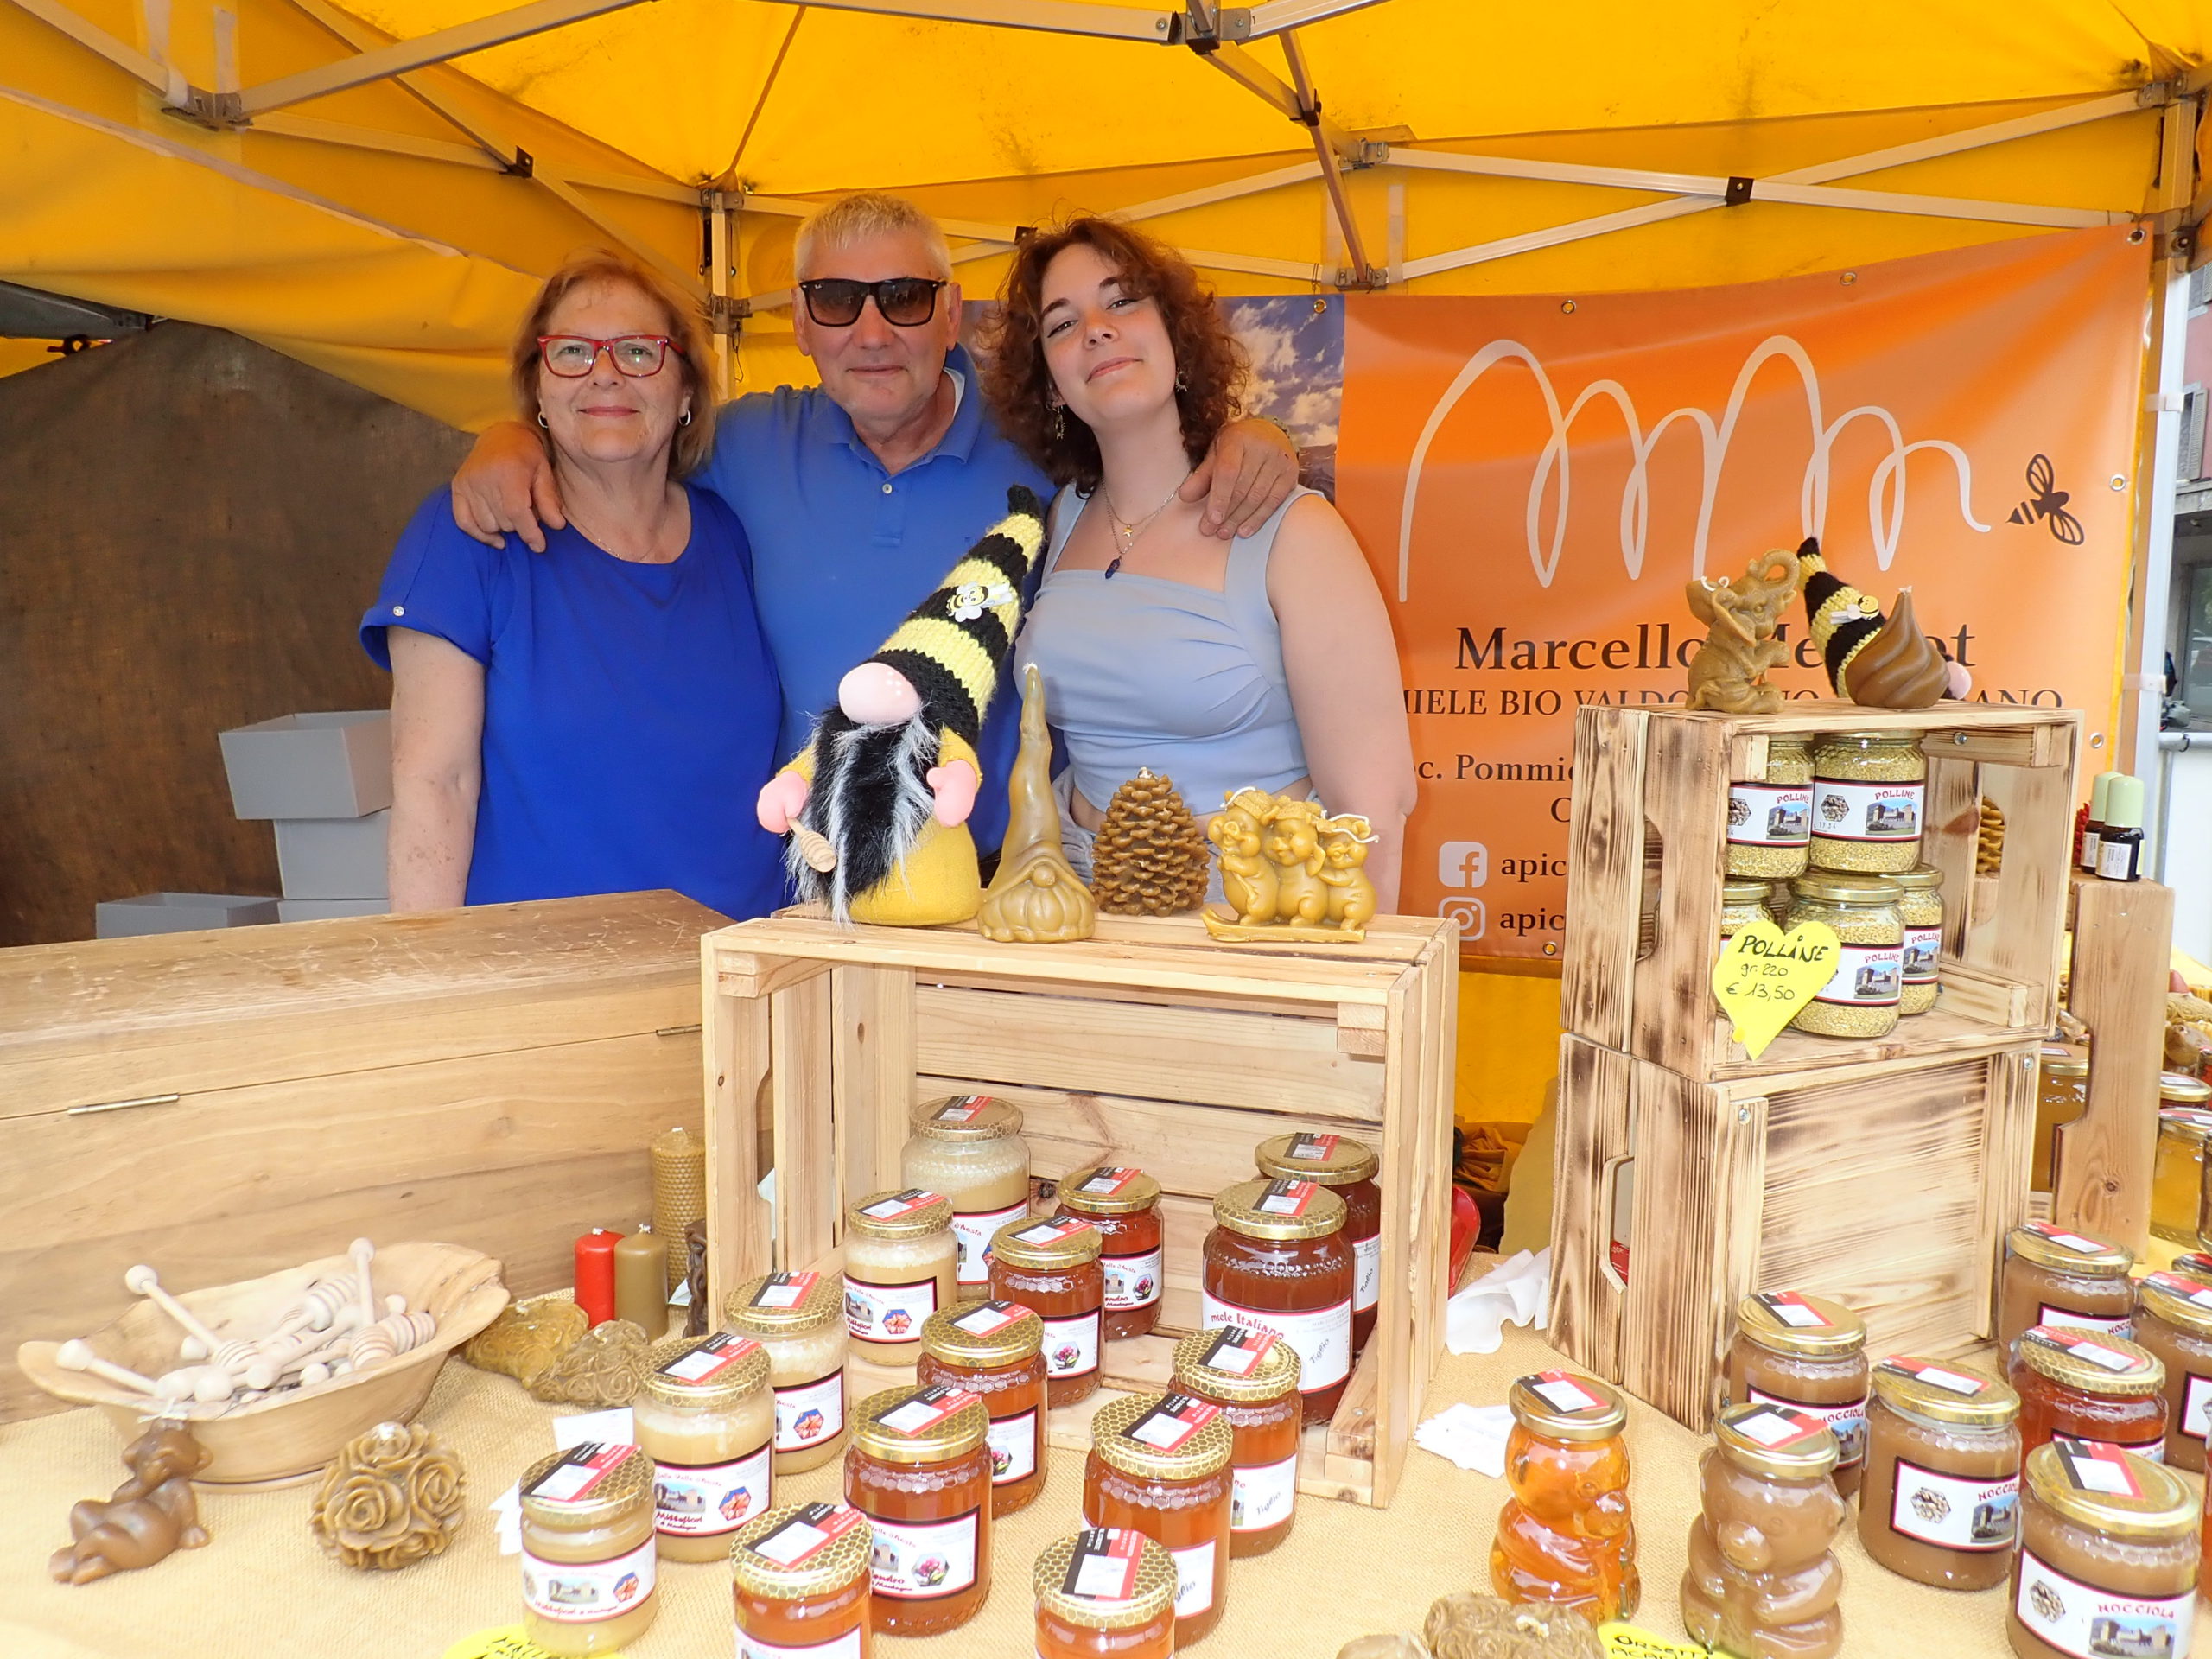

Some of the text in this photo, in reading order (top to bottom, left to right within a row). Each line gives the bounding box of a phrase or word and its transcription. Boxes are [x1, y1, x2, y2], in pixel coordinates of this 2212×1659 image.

[1499, 690, 1562, 715] BIO
[1874, 789, 1915, 800] POLLINE
[1762, 963, 1789, 976] 220
[1745, 983, 1796, 1002] 13,50
[1211, 1311, 1233, 1323] miele
[1308, 1338, 1330, 1364] Tiglio
[2098, 1604, 2175, 1618] NOCCIOLA
